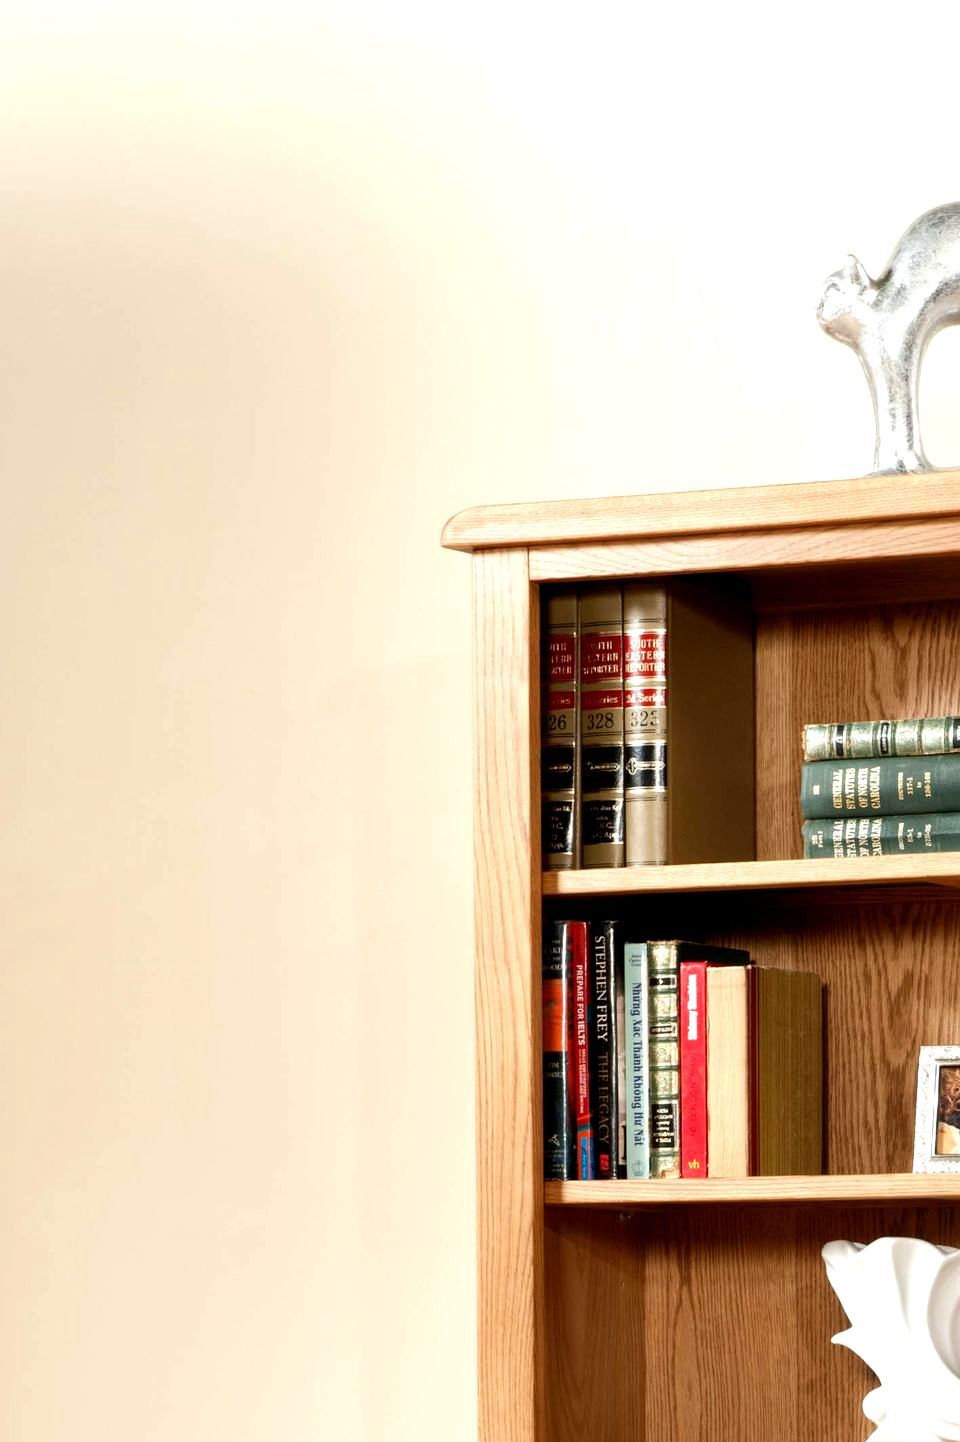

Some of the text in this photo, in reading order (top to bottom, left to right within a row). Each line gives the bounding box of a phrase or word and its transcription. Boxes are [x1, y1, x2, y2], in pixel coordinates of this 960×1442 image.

[625, 662, 665, 672] REPORTER
[548, 714, 567, 730] 26
[587, 712, 614, 730] 328
[630, 710, 659, 728] 323
[832, 769, 843, 809] GENERAL
[845, 768, 856, 810] STATUTES
[857, 768, 868, 808] OF NORTH
[870, 766, 881, 809] CAROLINA
[832, 820, 844, 858] GENERAL
[845, 819, 857, 858] STATUTES
[858, 818, 870, 846] NORTH
[871, 818, 883, 856] CAROLINA
[575, 965, 585, 1002] PREPARE
[594, 935, 609, 1042] STEPHEN FREY
[576, 1003, 585, 1020] FOR
[577, 1020, 586, 1046] IELTS
[597, 1051, 609, 1082] THE
[597, 1086, 610, 1145] LEGACY
